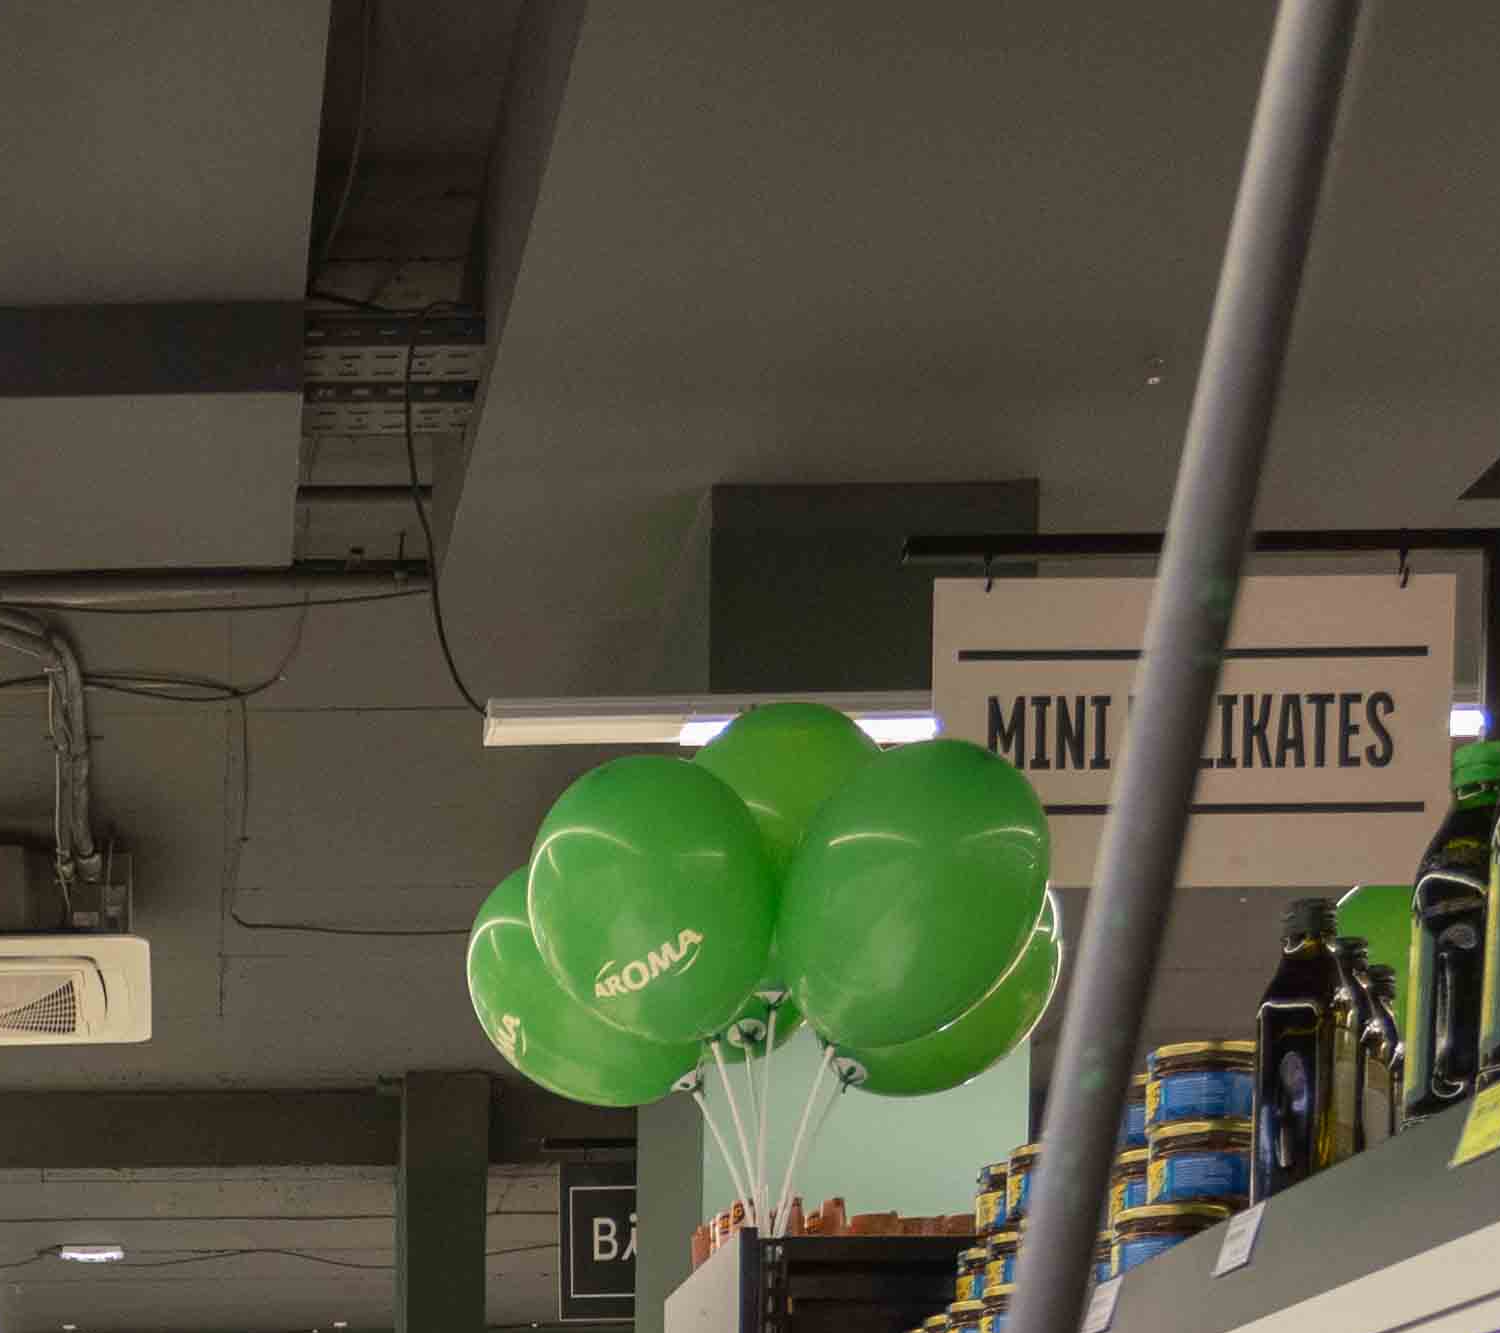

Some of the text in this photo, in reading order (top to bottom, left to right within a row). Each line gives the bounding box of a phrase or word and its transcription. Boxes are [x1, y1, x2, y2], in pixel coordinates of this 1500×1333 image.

[986, 690, 1396, 772] MINI IKATES
[595, 927, 703, 1000] AROMA
